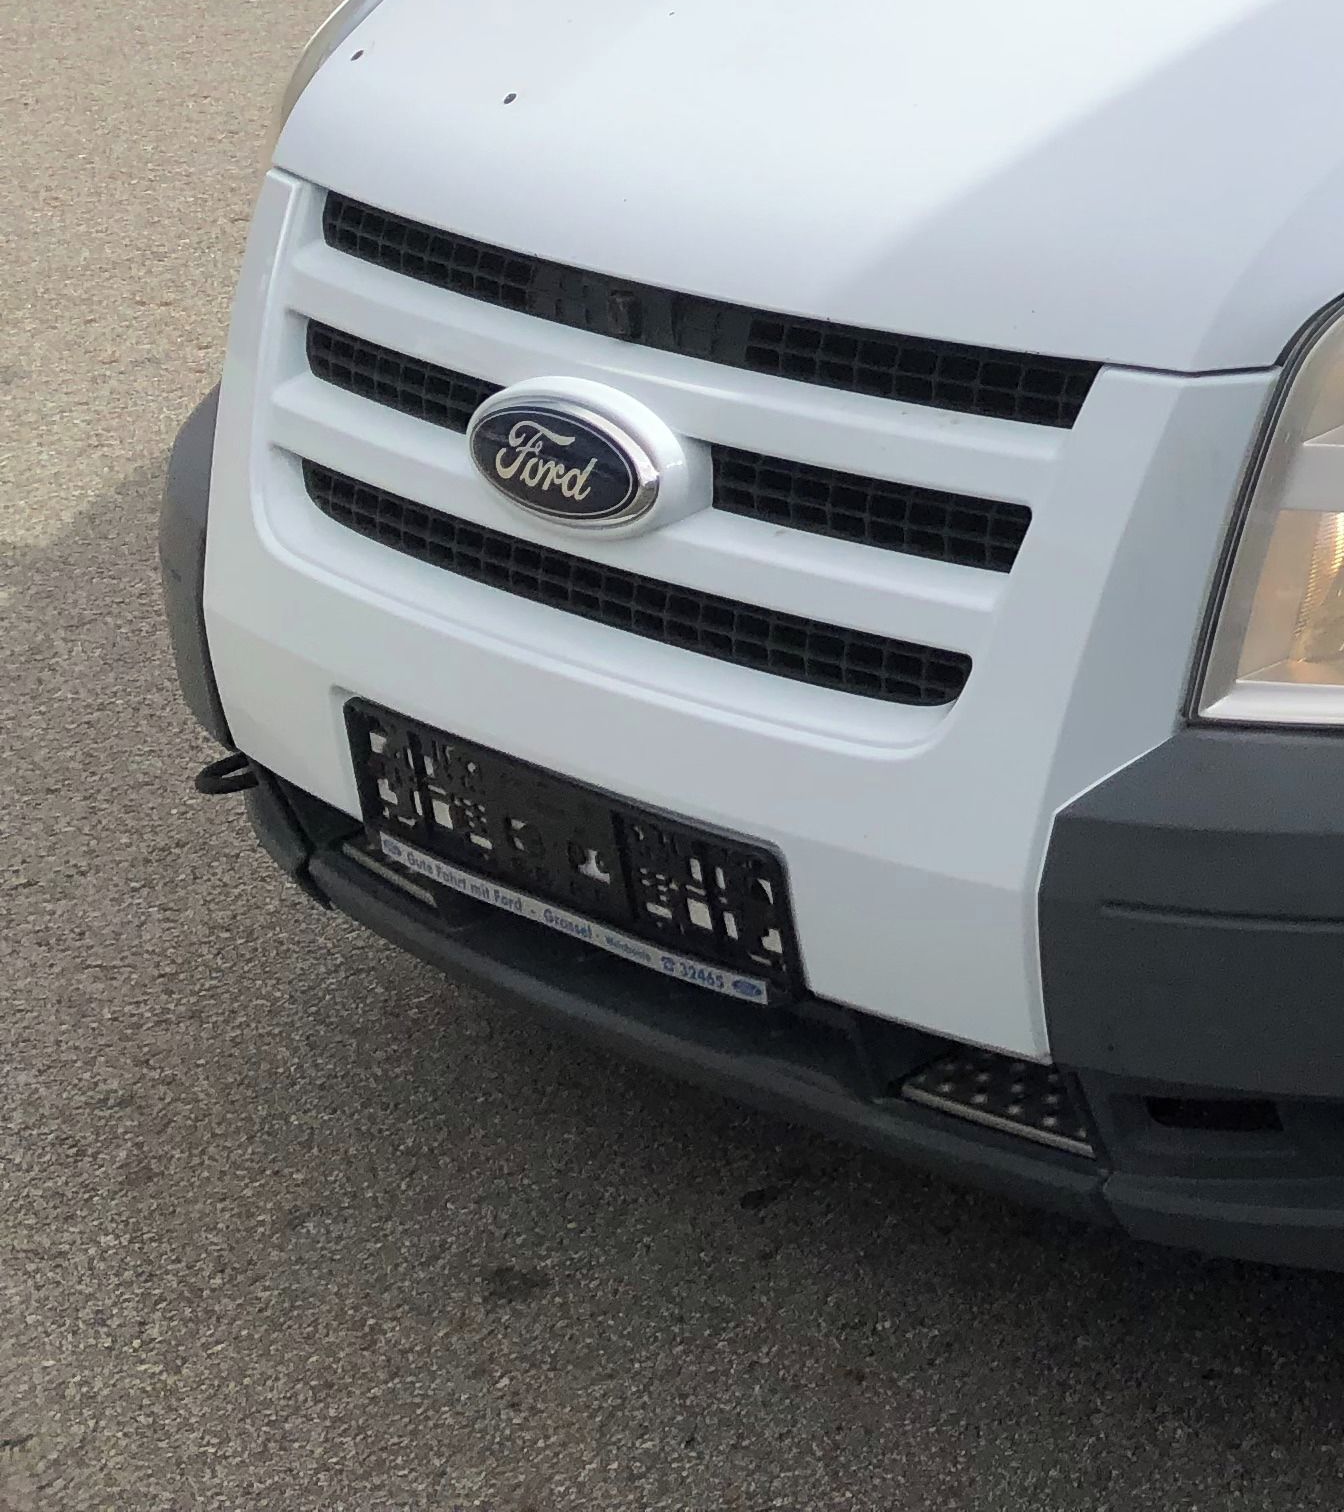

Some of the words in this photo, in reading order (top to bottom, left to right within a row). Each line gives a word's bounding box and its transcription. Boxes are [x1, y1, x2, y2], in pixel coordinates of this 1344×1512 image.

[495, 420, 598, 501] Ford
[406, 851, 433, 875] Gute
[470, 883, 490, 900] mit
[494, 889, 523, 912] Ford
